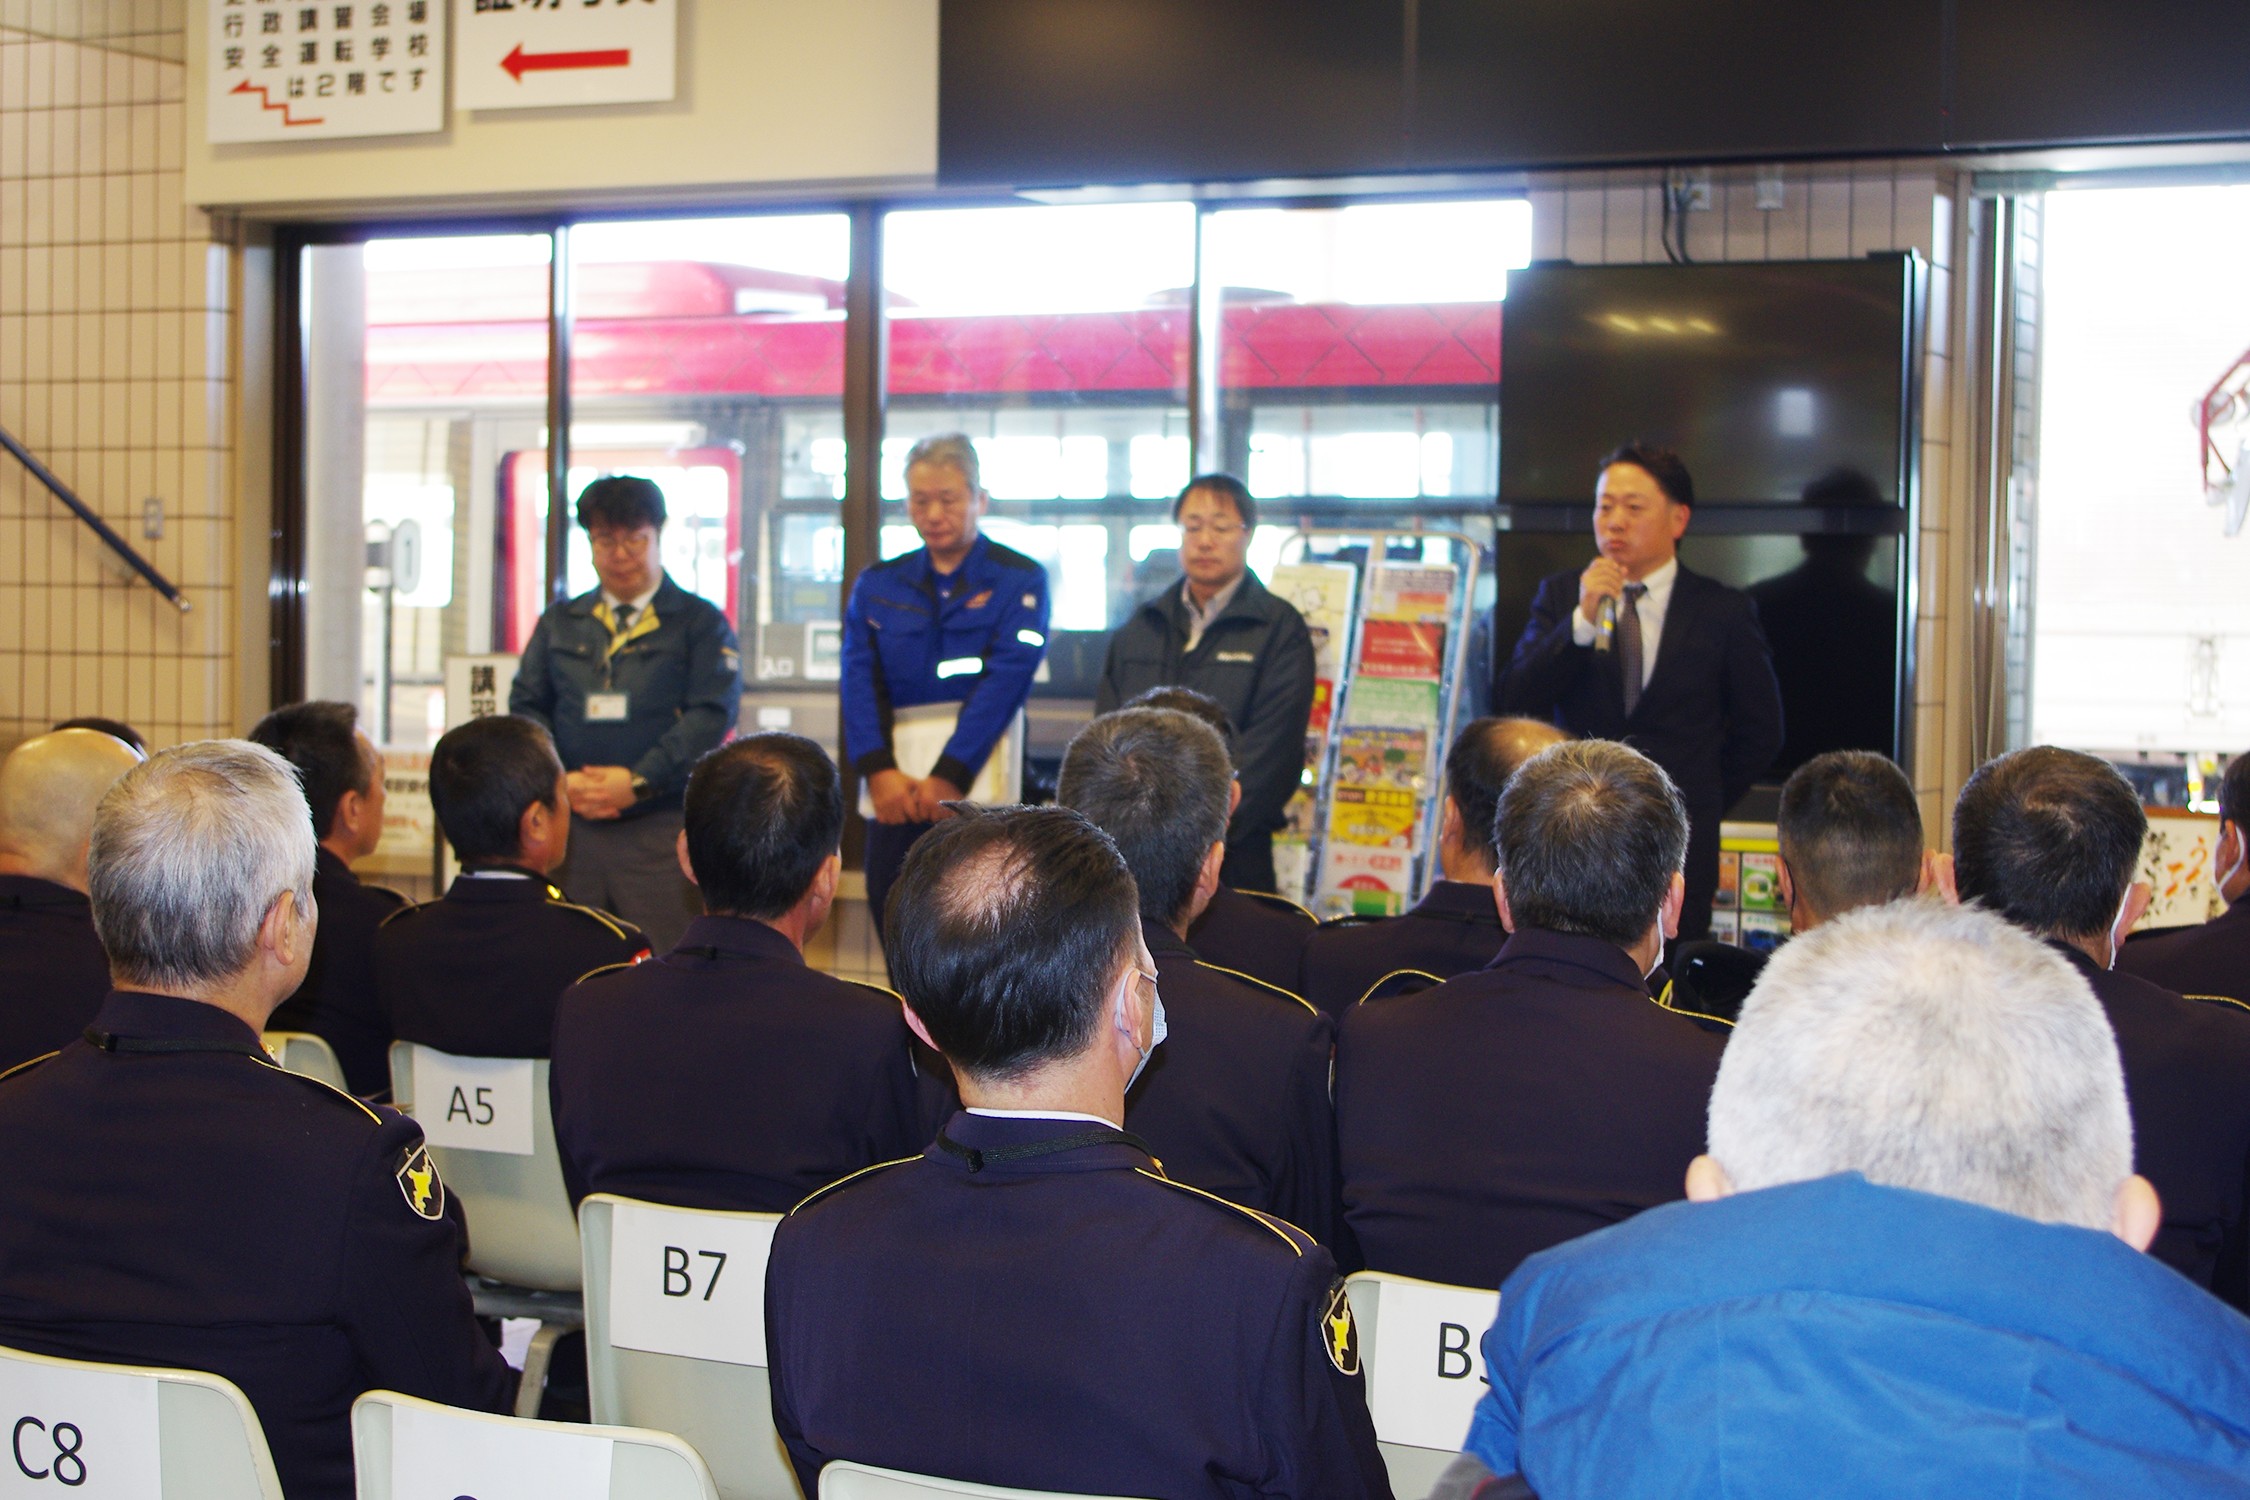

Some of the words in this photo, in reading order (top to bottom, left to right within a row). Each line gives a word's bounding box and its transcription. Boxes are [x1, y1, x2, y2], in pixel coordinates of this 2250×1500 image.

[224, 0, 428, 38] 行政講習会場
[224, 34, 428, 70] 安全運転学校
[287, 68, 426, 98] は2階です
[447, 1086, 494, 1126] A5
[663, 1246, 727, 1301] B7
[12, 1416, 87, 1486] C8
